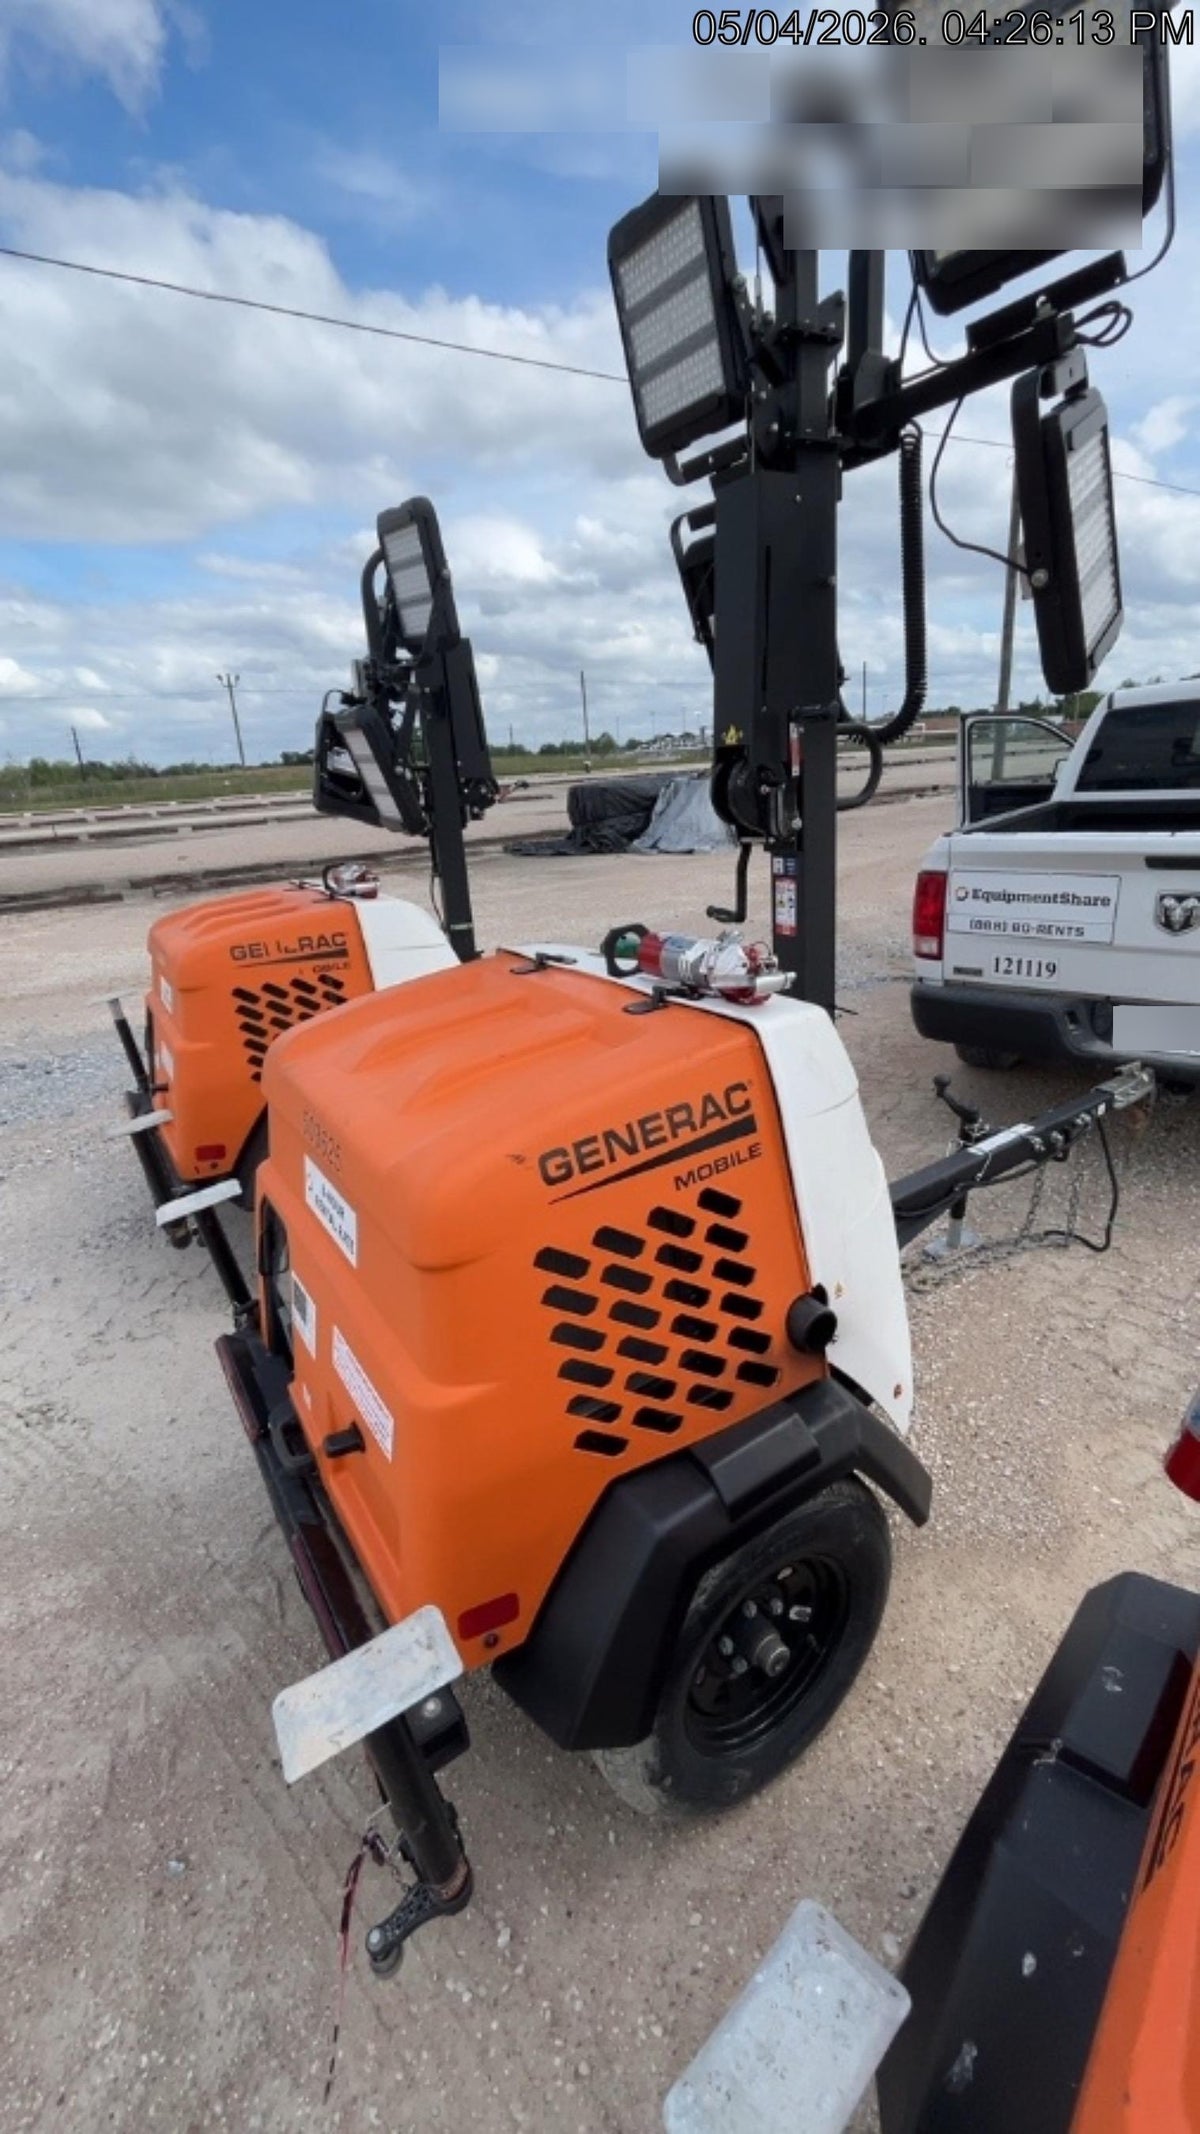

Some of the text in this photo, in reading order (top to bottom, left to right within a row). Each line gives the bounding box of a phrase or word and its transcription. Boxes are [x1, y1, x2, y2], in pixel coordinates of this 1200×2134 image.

[971, 888, 1111, 907] EquipmentShare
[993, 956, 1057, 978] 121119
[538, 1082, 752, 1187] GENERAC
[673, 1141, 763, 1192] MOBILE
